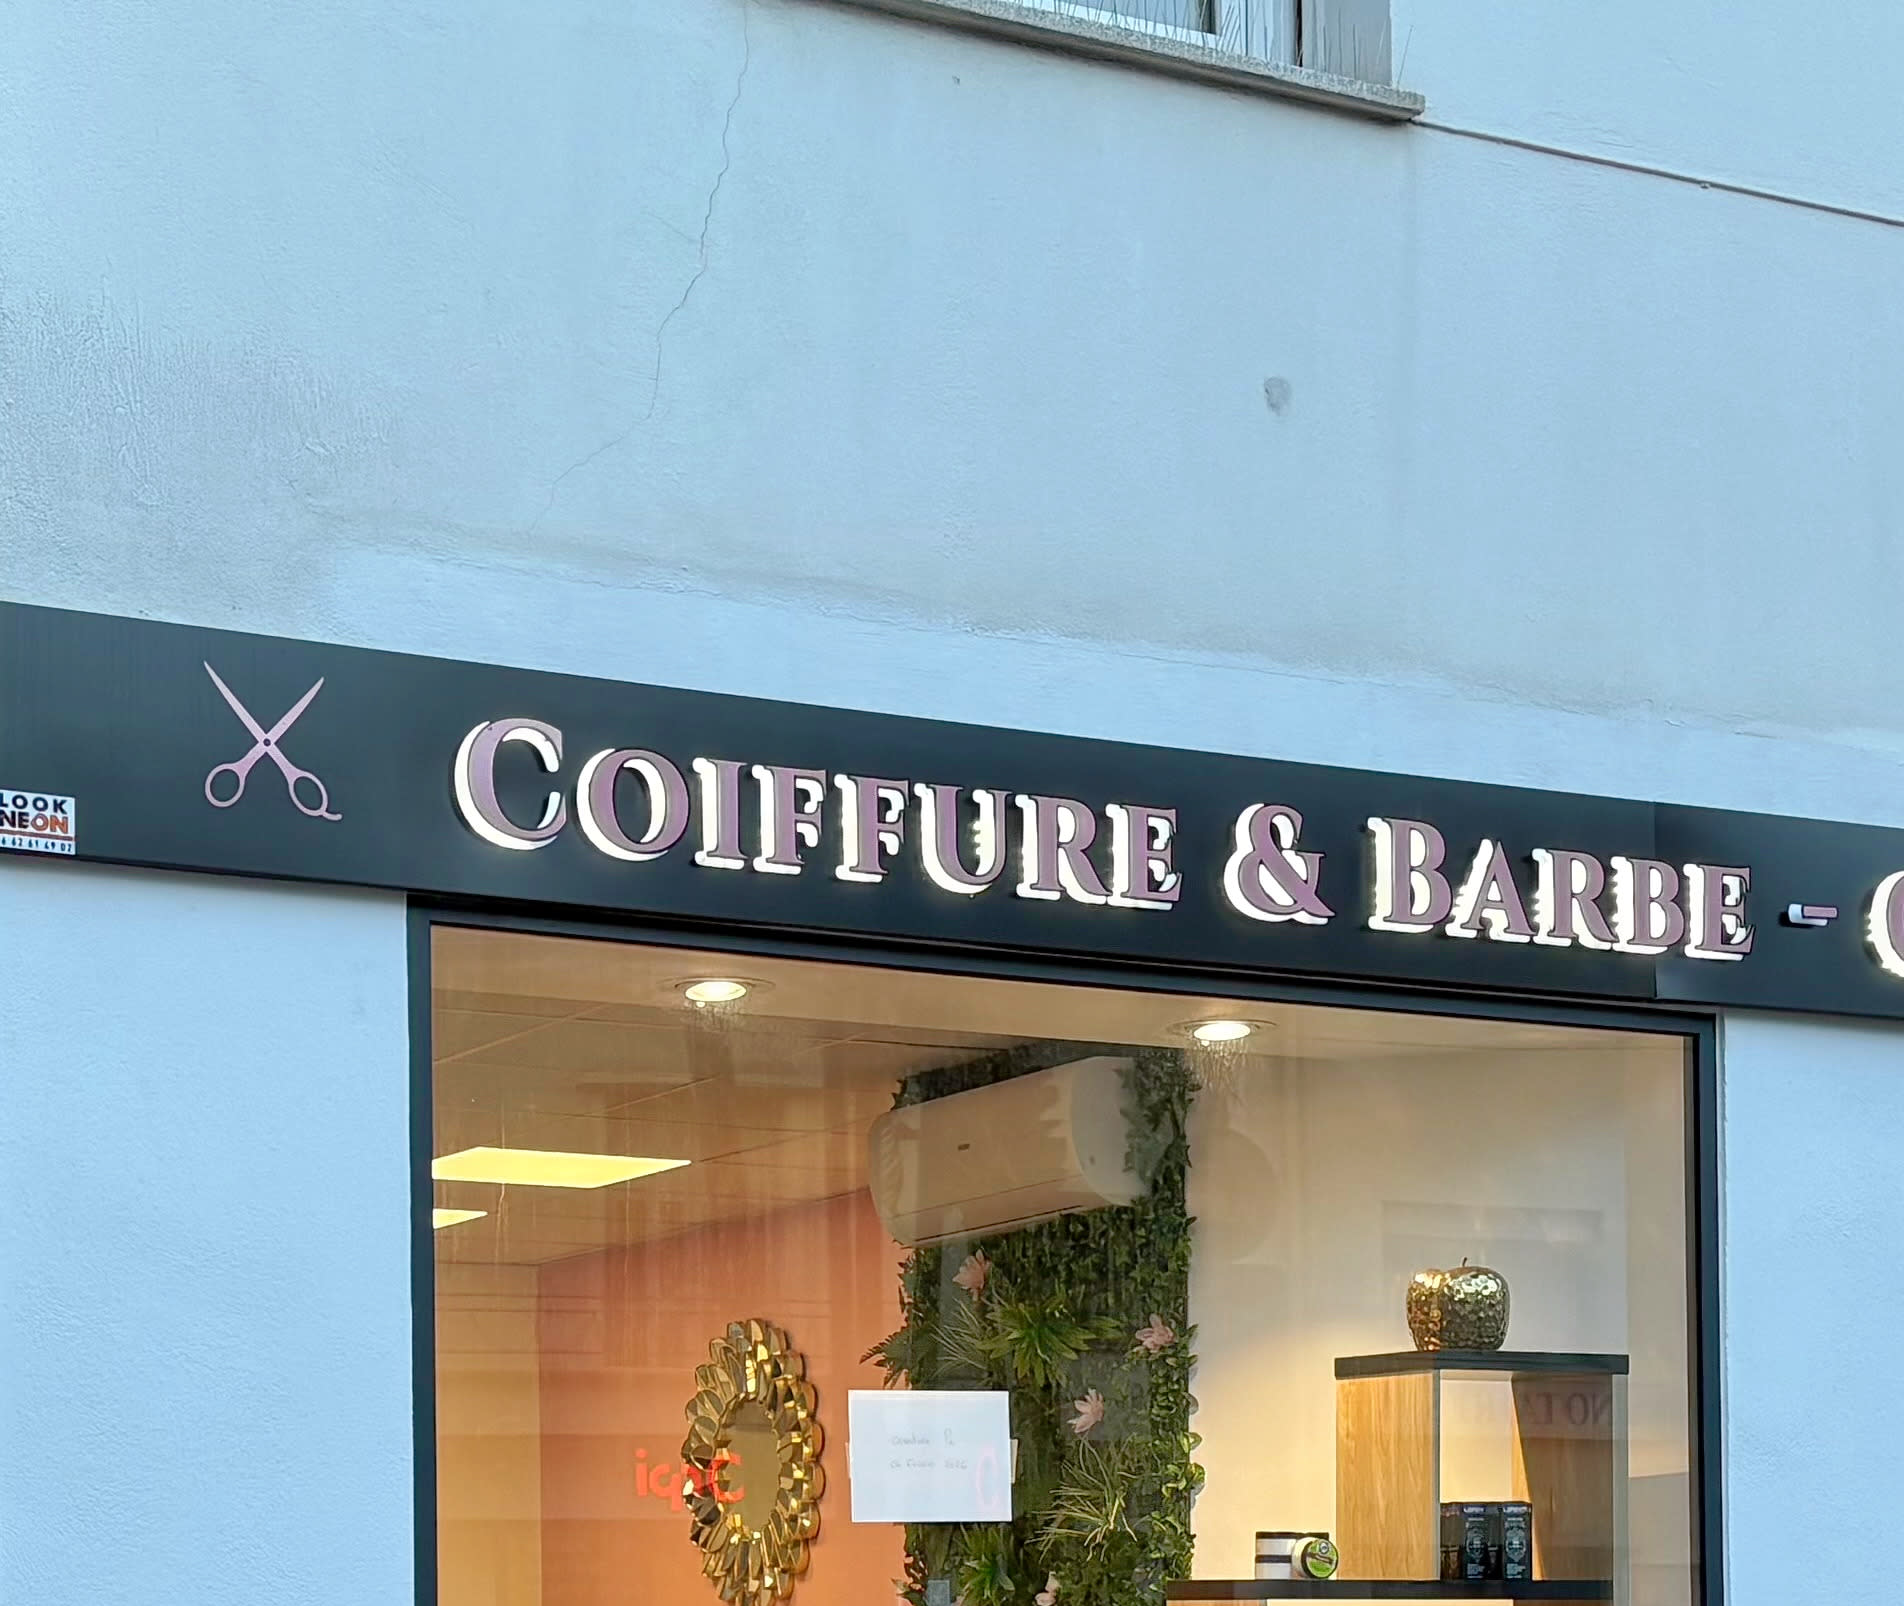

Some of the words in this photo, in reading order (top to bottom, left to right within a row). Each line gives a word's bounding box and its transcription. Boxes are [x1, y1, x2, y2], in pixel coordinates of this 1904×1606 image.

[453, 718, 1180, 909] COIFFURE
[1223, 803, 1333, 925] &
[1368, 816, 1755, 960] BARBE
